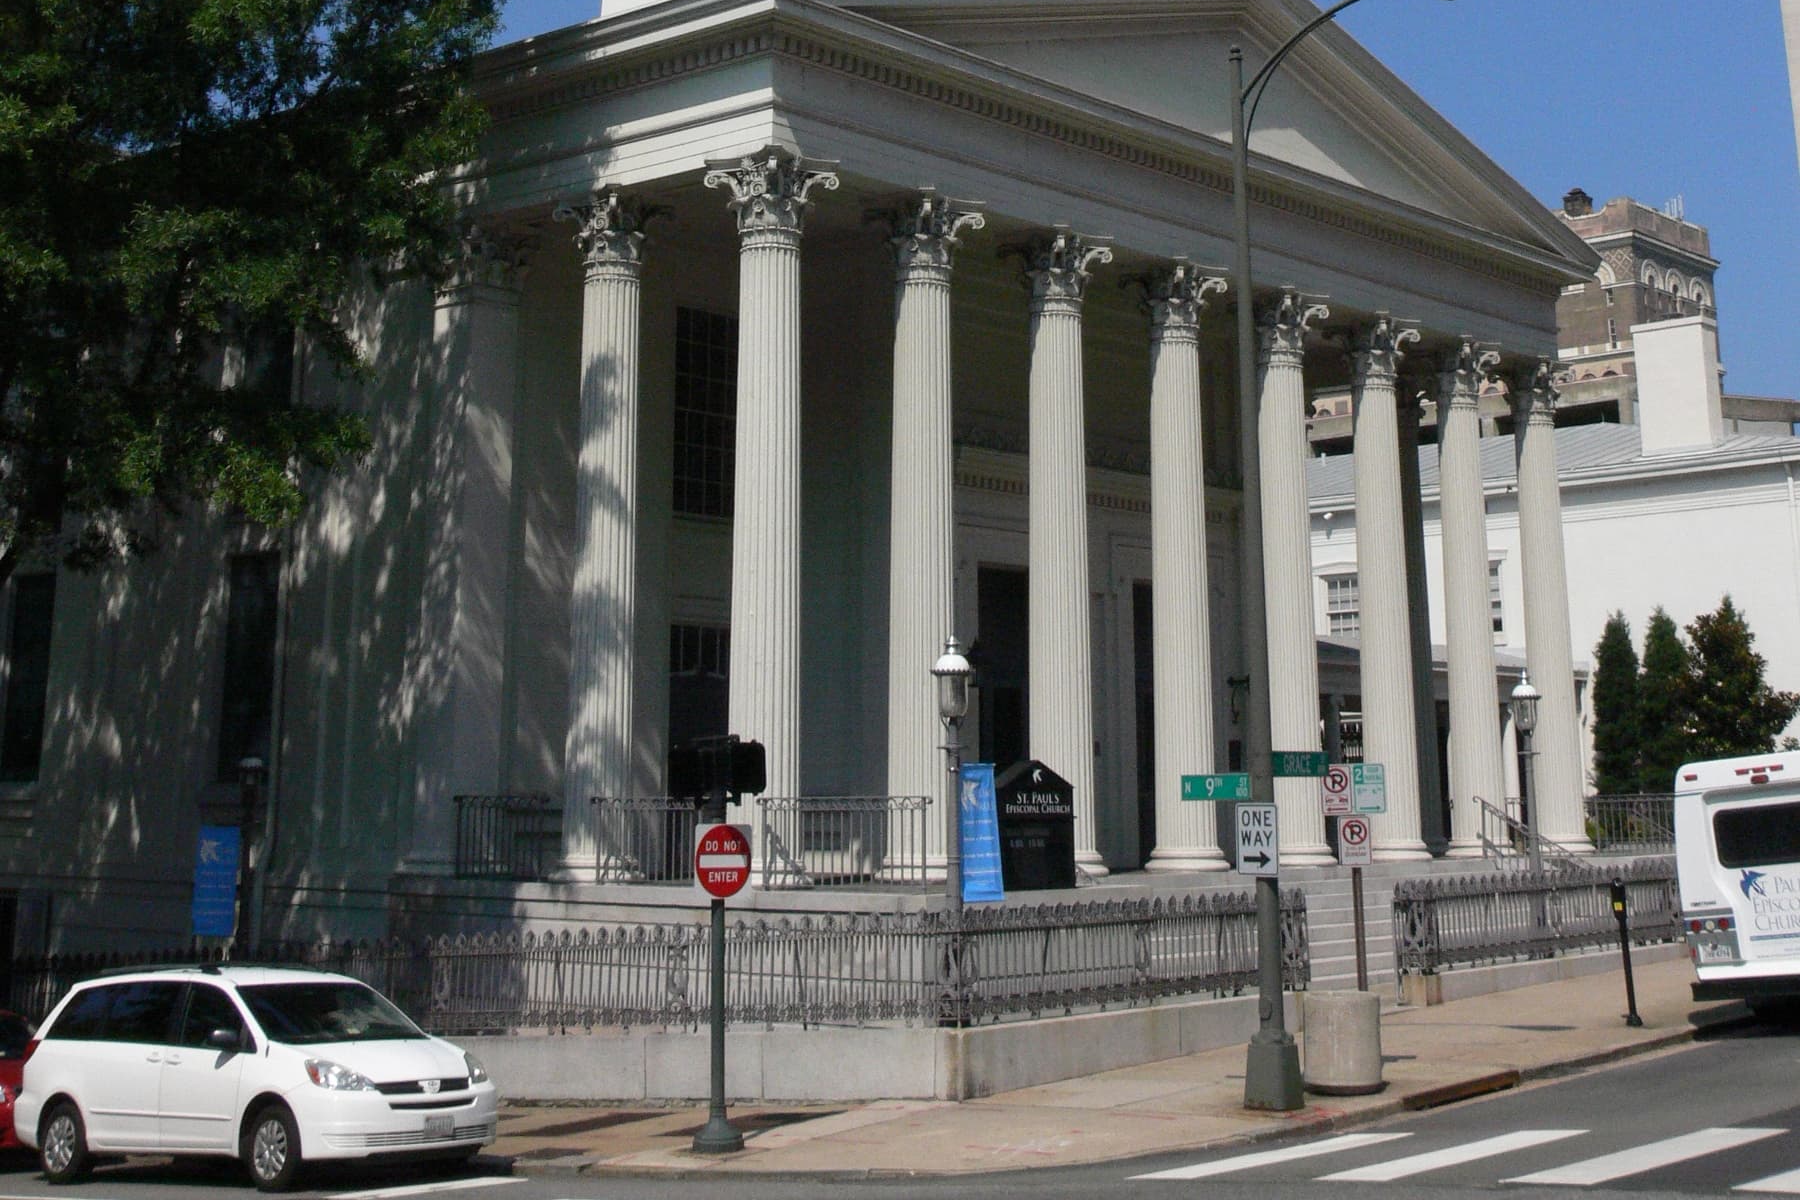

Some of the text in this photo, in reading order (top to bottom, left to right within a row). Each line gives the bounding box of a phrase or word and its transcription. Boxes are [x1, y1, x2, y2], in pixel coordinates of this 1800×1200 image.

[1284, 753, 1311, 774] GRACE
[1355, 768, 1361, 781] 2
[1006, 804, 1070, 814] EPISCOPAL CHURCH
[1241, 810, 1272, 827] ONE
[1241, 830, 1273, 847] WAY
[705, 840, 718, 851] DO
[709, 872, 738, 882] ENTER
